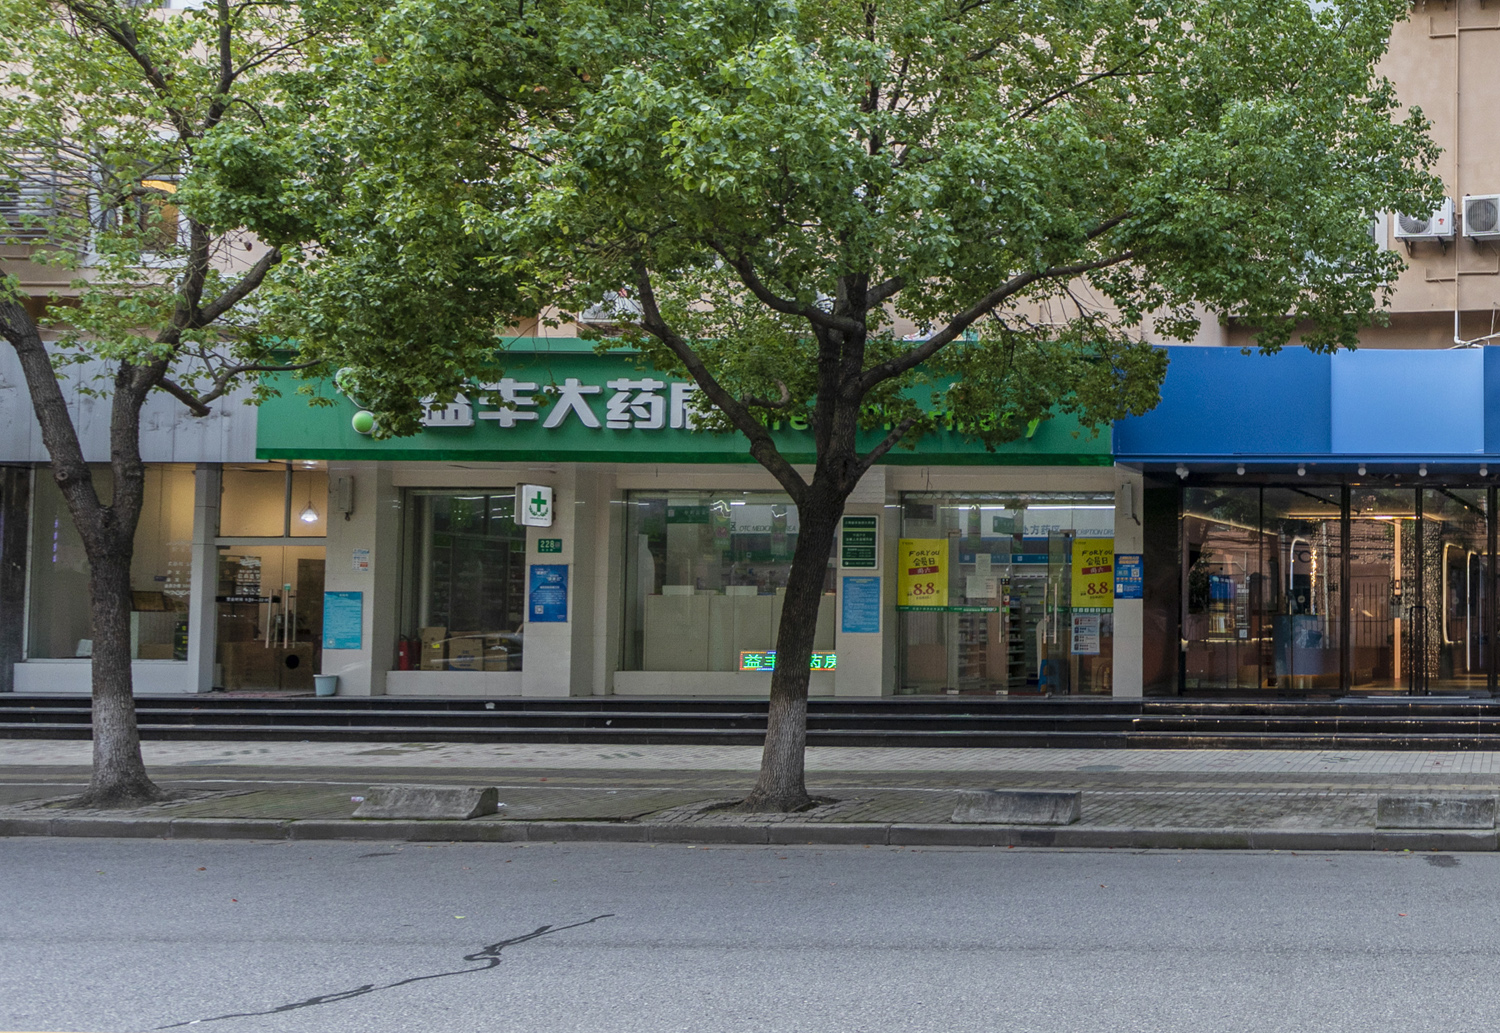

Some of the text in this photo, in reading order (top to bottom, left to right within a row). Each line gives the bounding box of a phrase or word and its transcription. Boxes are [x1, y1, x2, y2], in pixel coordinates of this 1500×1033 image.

[540, 540, 555, 548] 228
[913, 557, 936, 566] 会员日
[1086, 556, 1109, 566] 会员日
[913, 582, 935, 596] 8.8
[1087, 581, 1109, 595] 8.8
[743, 654, 837, 669] 益丰药房
